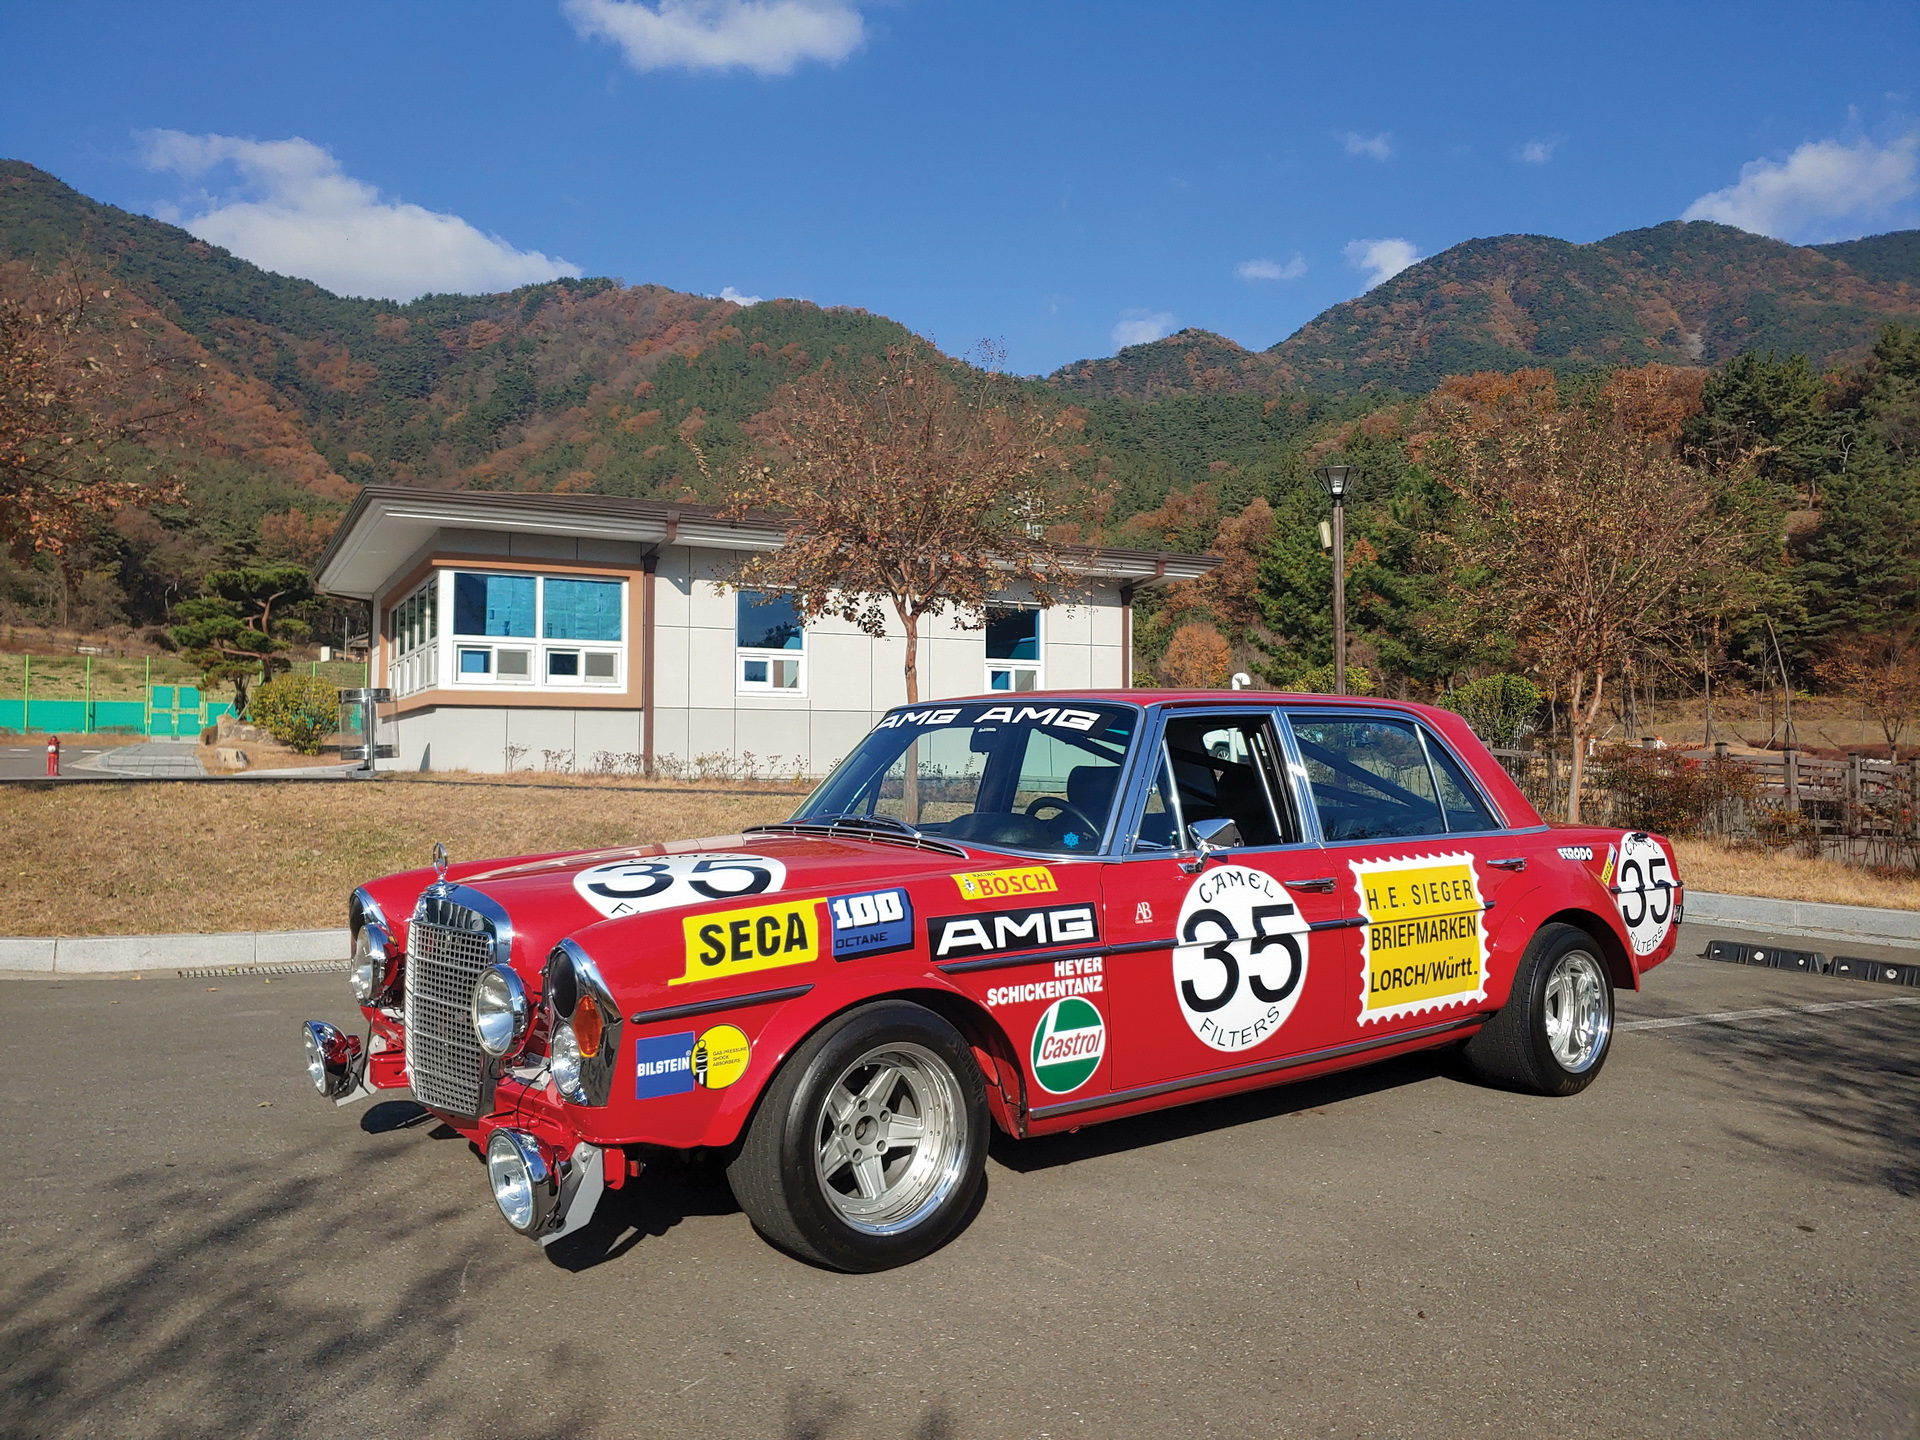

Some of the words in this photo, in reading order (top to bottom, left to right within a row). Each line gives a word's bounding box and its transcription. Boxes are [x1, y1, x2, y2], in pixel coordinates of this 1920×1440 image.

[871, 708, 962, 732] AMG
[973, 706, 1101, 731] AMG
[1557, 847, 1593, 860] FERODO
[588, 858, 772, 899] 35
[978, 872, 1052, 897] BOSCH
[1199, 871, 1274, 903] CAMEL
[1621, 858, 1671, 928] 35
[1366, 886, 1406, 910] H.E.
[1411, 879, 1474, 906] SIEGER
[833, 891, 904, 930] 100
[1135, 901, 1152, 920] AB
[699, 912, 809, 966] SECA
[835, 931, 889, 949] OCTANE
[936, 908, 1094, 956] AMG
[1371, 915, 1477, 951] BRIEFMARKEN
[1630, 926, 1664, 953] FILTERS
[1054, 956, 1103, 977] HEYER
[1181, 903, 1302, 1013] 35
[1370, 956, 1478, 993] LORCH/Württ.
[987, 975, 1103, 1006] SCHICKENTANZ
[1200, 1006, 1280, 1047] FILTERS
[723, 1046, 747, 1055] PRESSURE
[1042, 1029, 1103, 1061] Castrol
[637, 1056, 691, 1077] BILSTEIN
[712, 1058, 741, 1067] ABSORBERS
